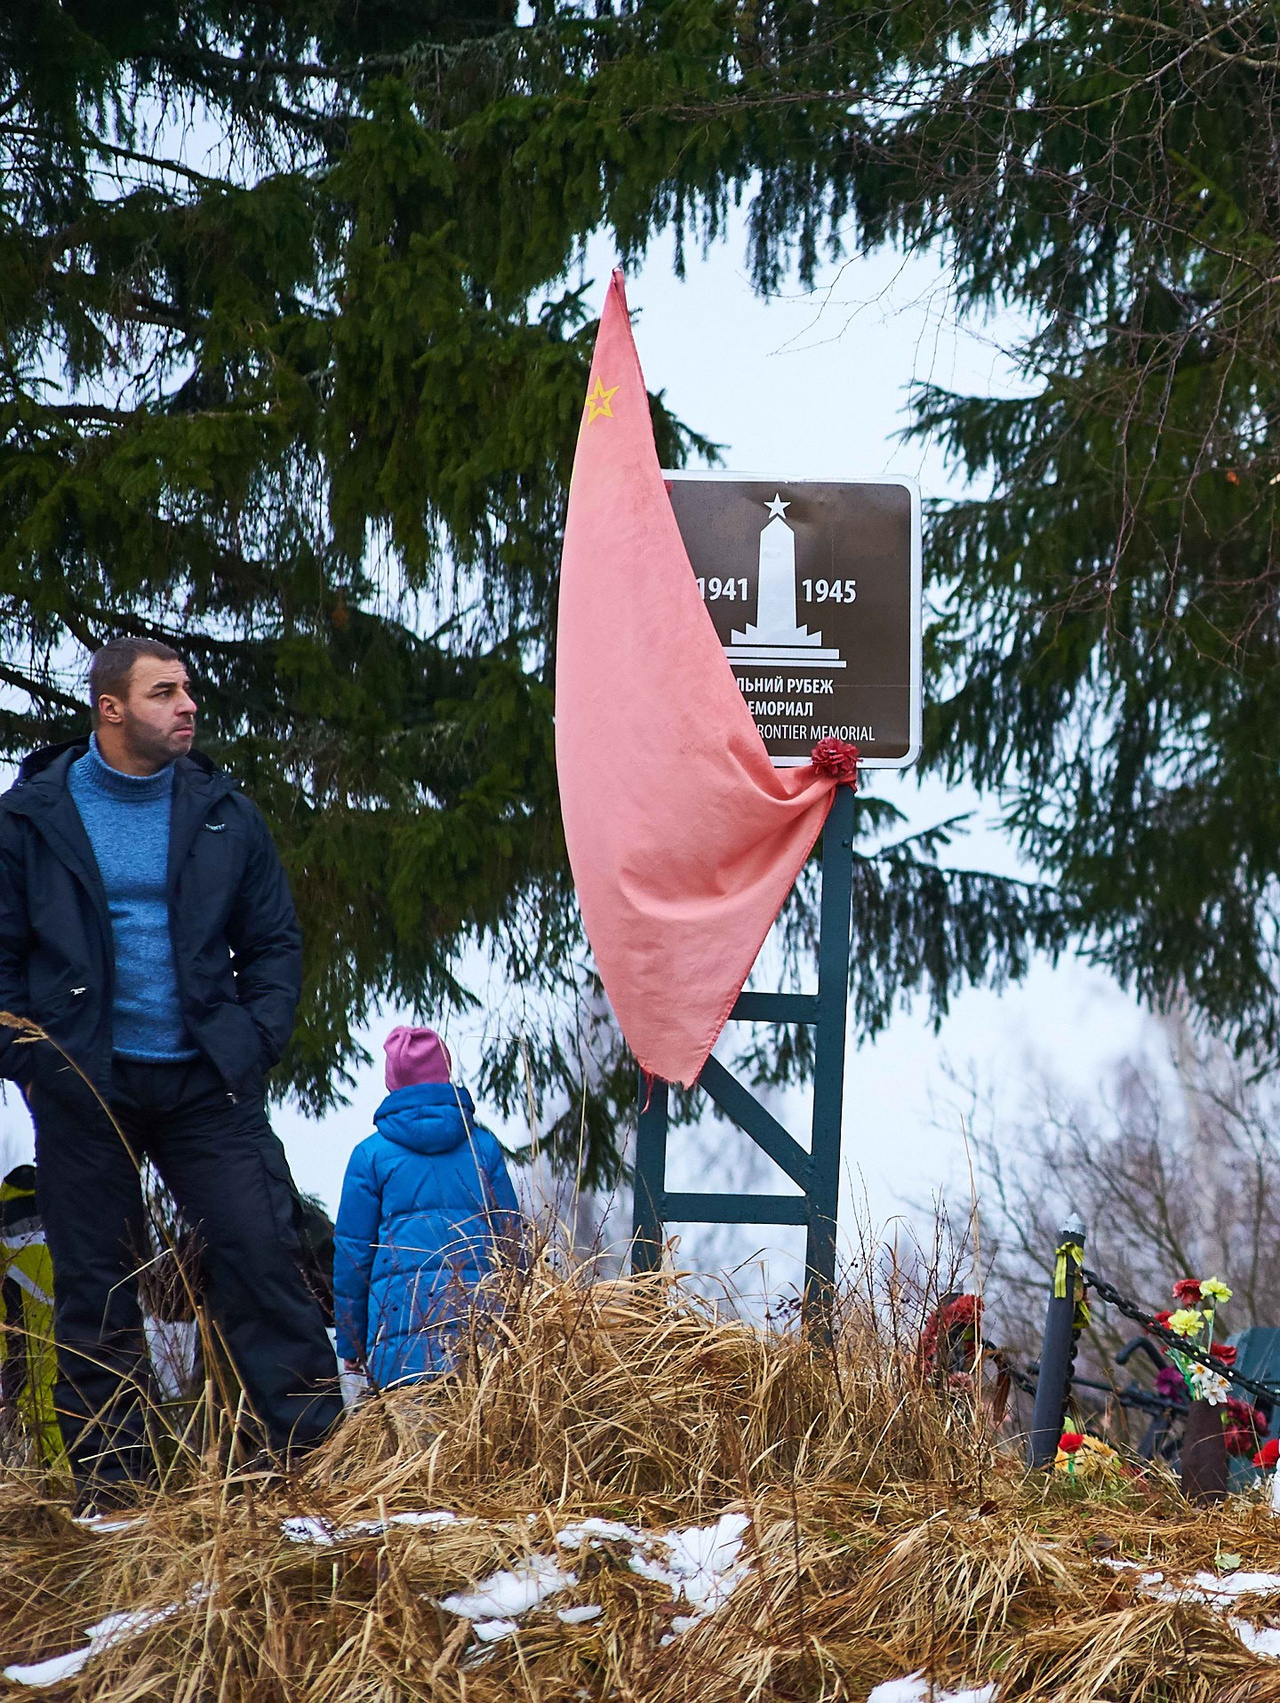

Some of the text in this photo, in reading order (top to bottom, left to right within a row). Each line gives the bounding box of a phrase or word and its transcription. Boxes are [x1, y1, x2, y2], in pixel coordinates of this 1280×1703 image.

[696, 577, 748, 601] 1941
[802, 579, 857, 603] 1945
[736, 676, 834, 695] ЛЬНИЙ РУБЕЖ
[747, 701, 813, 717] ЕМОРИАЛ
[756, 724, 875, 742] RONTIER MEMORIAL
